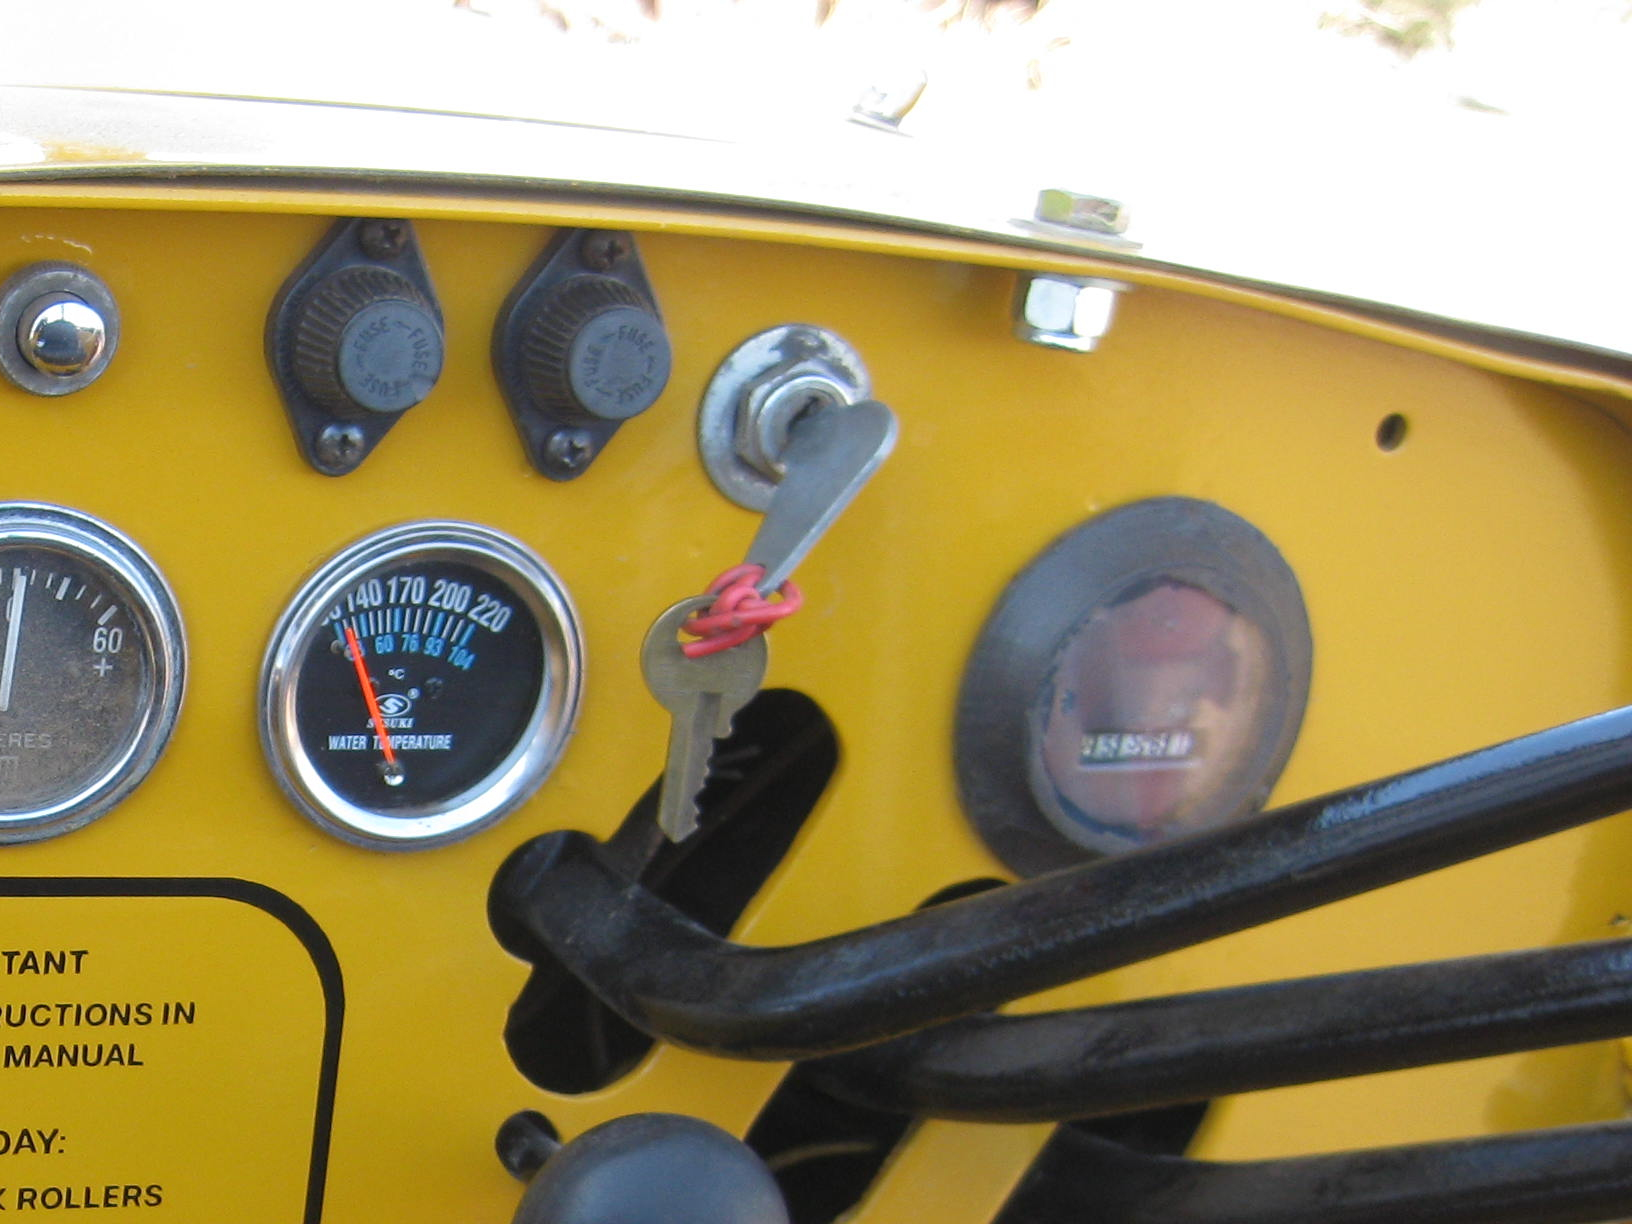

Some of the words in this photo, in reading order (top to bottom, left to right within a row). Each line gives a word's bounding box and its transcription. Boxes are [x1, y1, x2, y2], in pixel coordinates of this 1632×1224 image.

[387, 576, 426, 604] 170
[428, 578, 472, 613] 200
[468, 593, 513, 633] 220
[92, 628, 122, 653] 60
[375, 634, 395, 654] 60
[401, 634, 419, 653] 76
[424, 636, 444, 657] 93
[447, 645, 476, 670] 104
[329, 735, 368, 750] WATER
[162, 1002, 196, 1025] IN
[3, 1043, 144, 1068] MANUAL
[17, 1184, 163, 1210] ROLLERS
